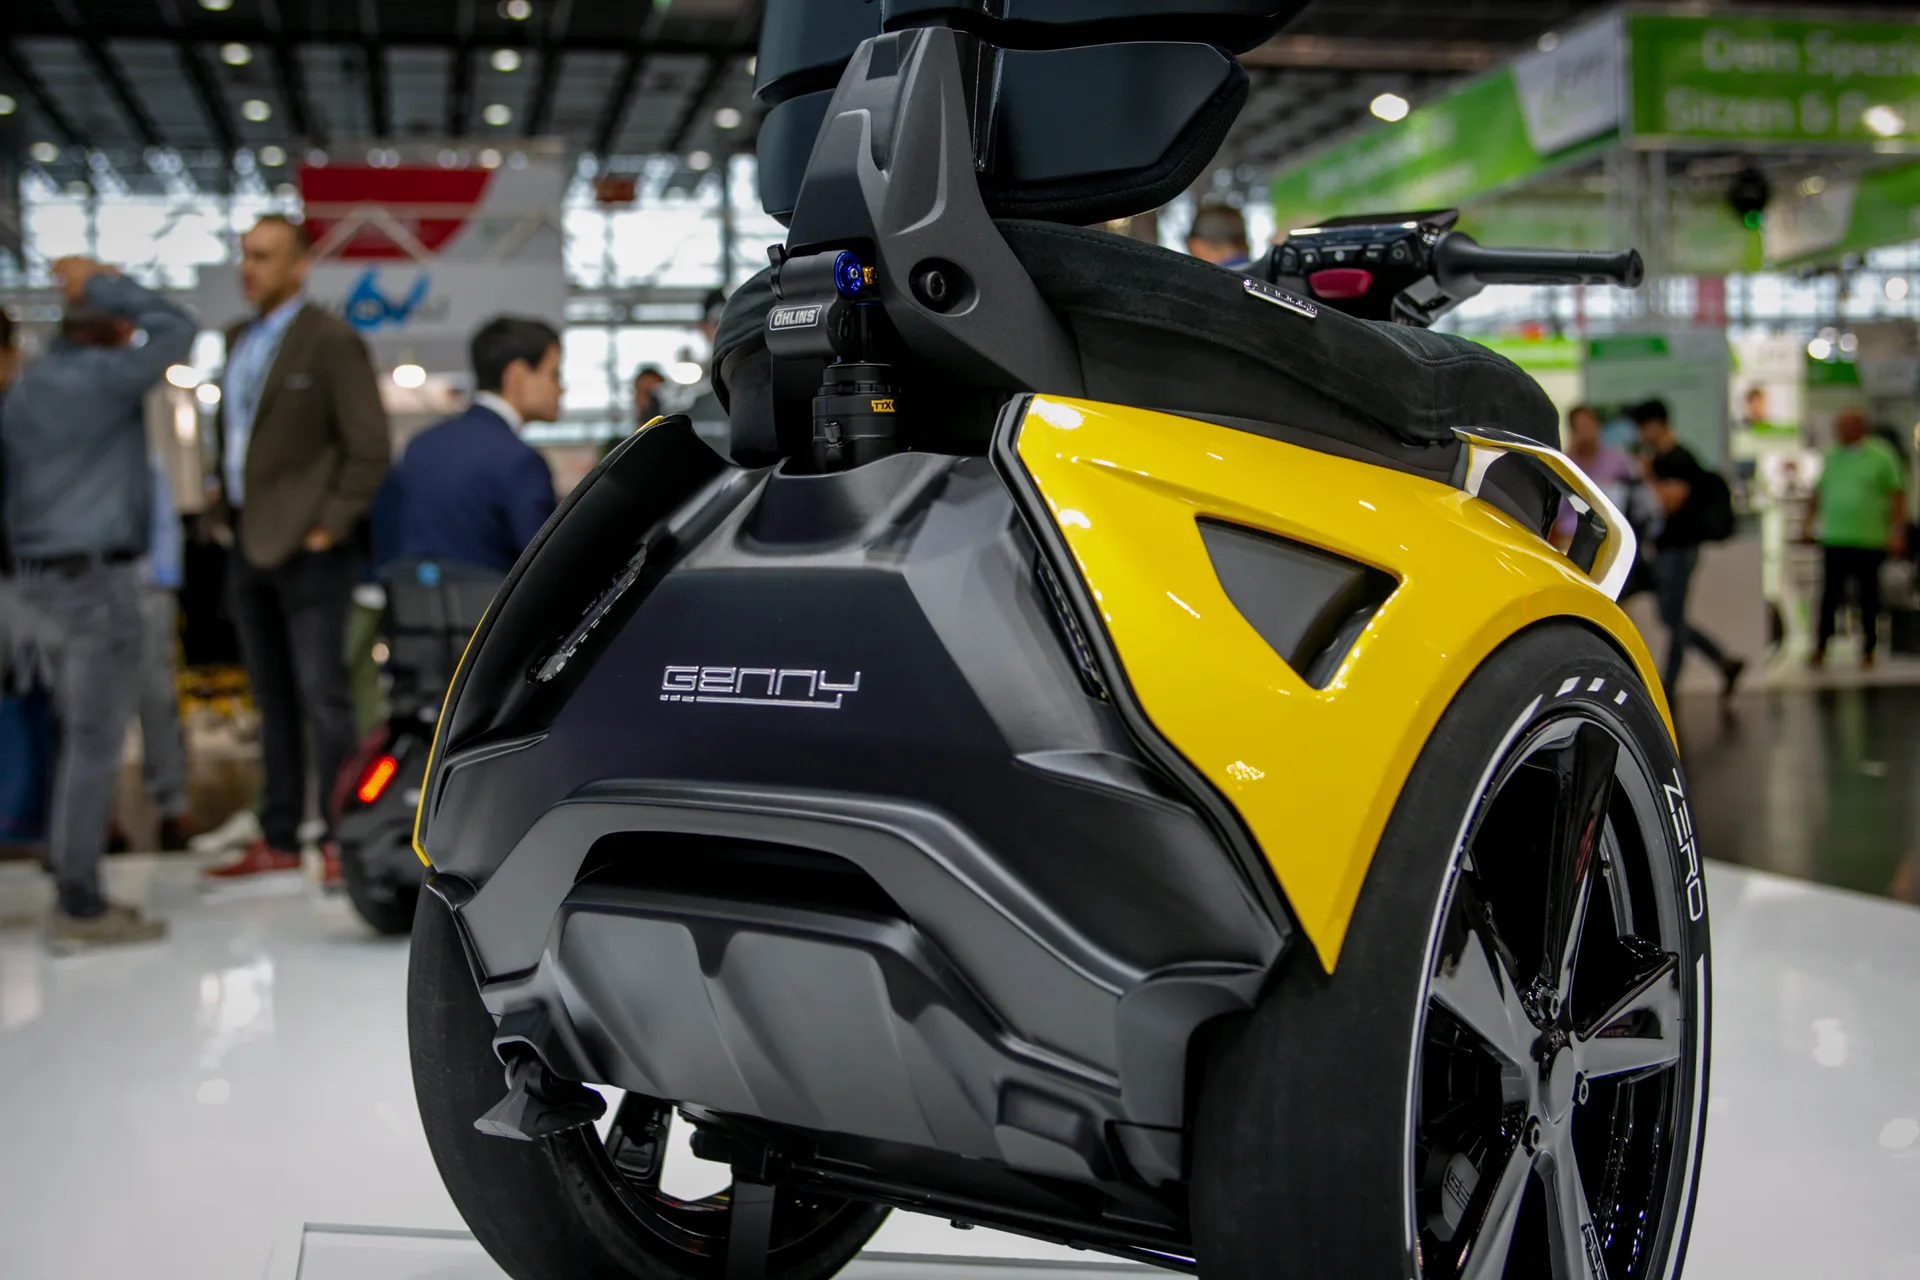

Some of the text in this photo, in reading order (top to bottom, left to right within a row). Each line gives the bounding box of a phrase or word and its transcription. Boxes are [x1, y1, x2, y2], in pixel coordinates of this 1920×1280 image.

[773, 309, 816, 326] ÖHLINS
[873, 401, 892, 410] TTX
[1663, 767, 1703, 922] ZERO
